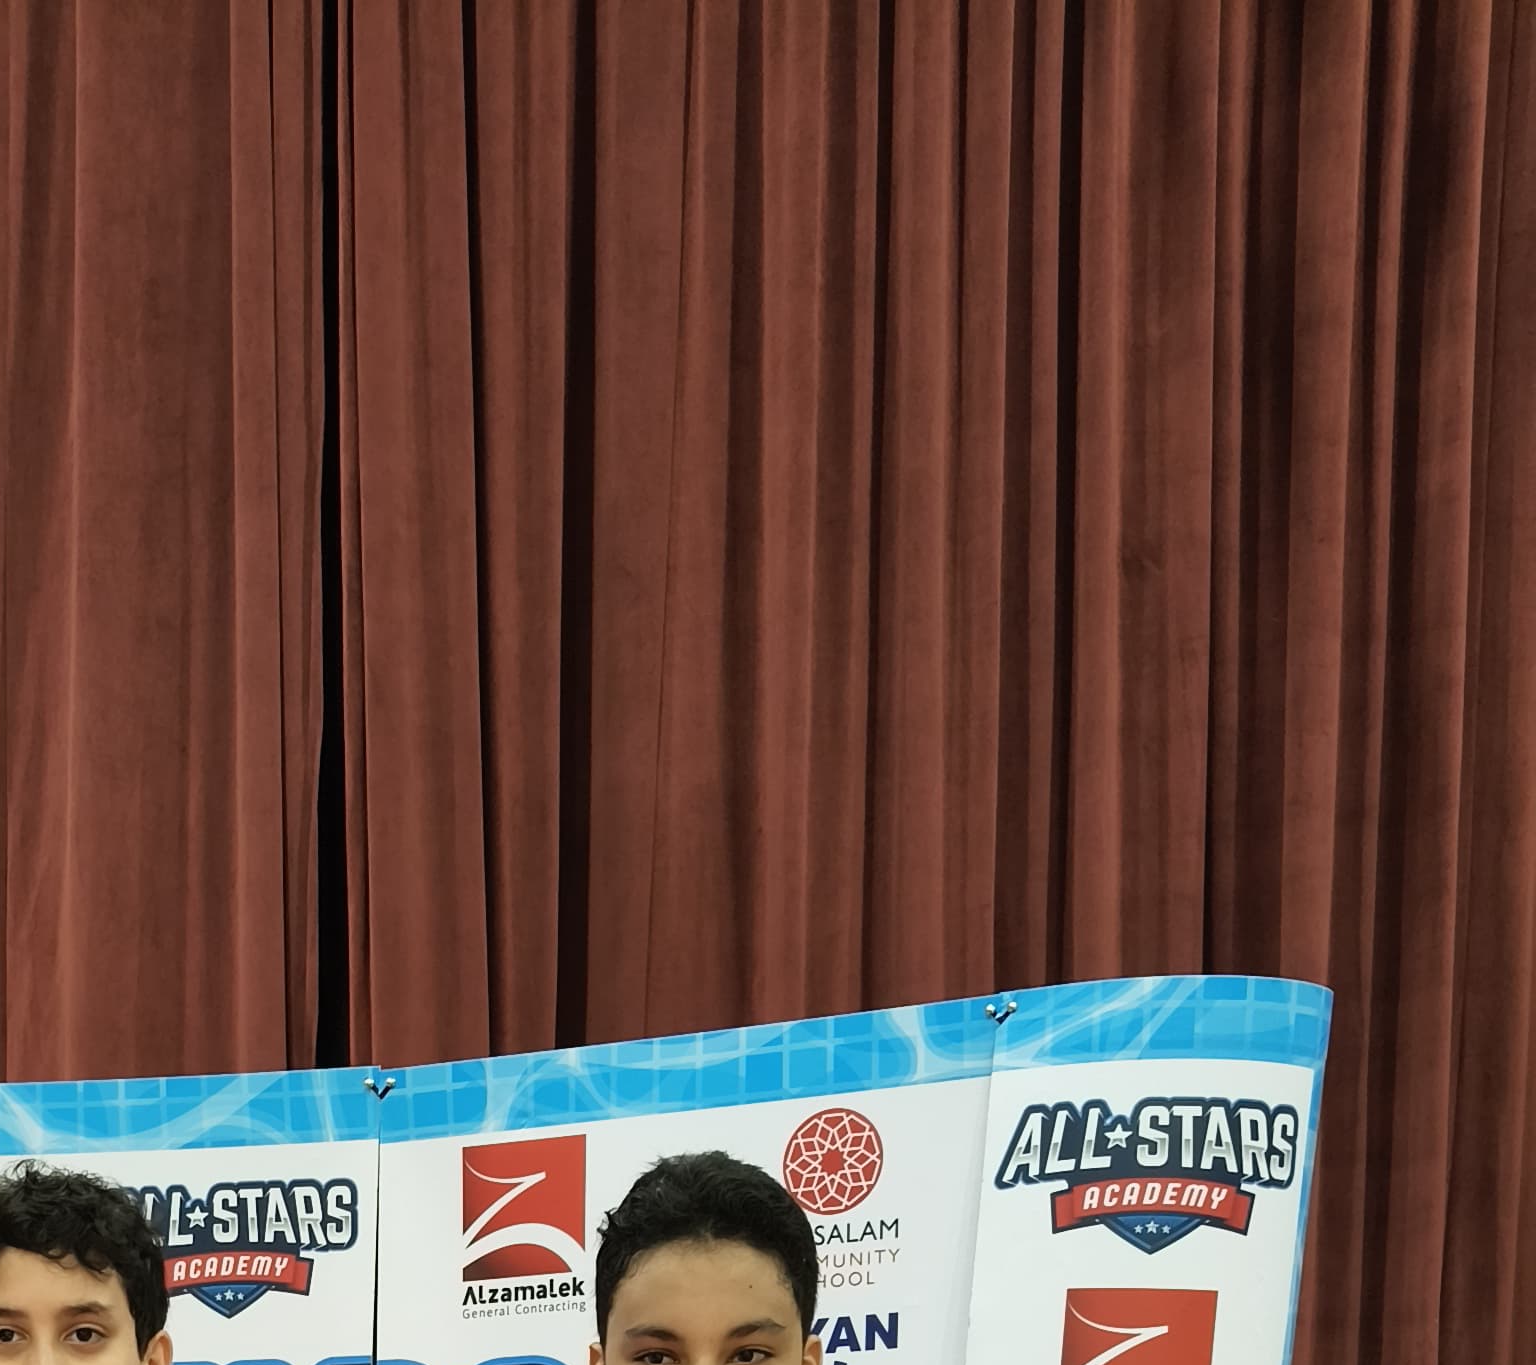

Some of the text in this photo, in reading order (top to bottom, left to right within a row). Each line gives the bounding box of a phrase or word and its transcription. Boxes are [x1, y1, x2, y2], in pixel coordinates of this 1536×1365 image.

[1002, 1104, 1299, 1187] ALL STARS
[1082, 1181, 1229, 1211] ACADEMY
[212, 1183, 353, 1249] STARS
[814, 1218, 899, 1246] SALAM
[173, 1255, 288, 1281] ACADEMY
[462, 1277, 585, 1307] Alzamalek
[462, 1299, 587, 1320] General Contracting
